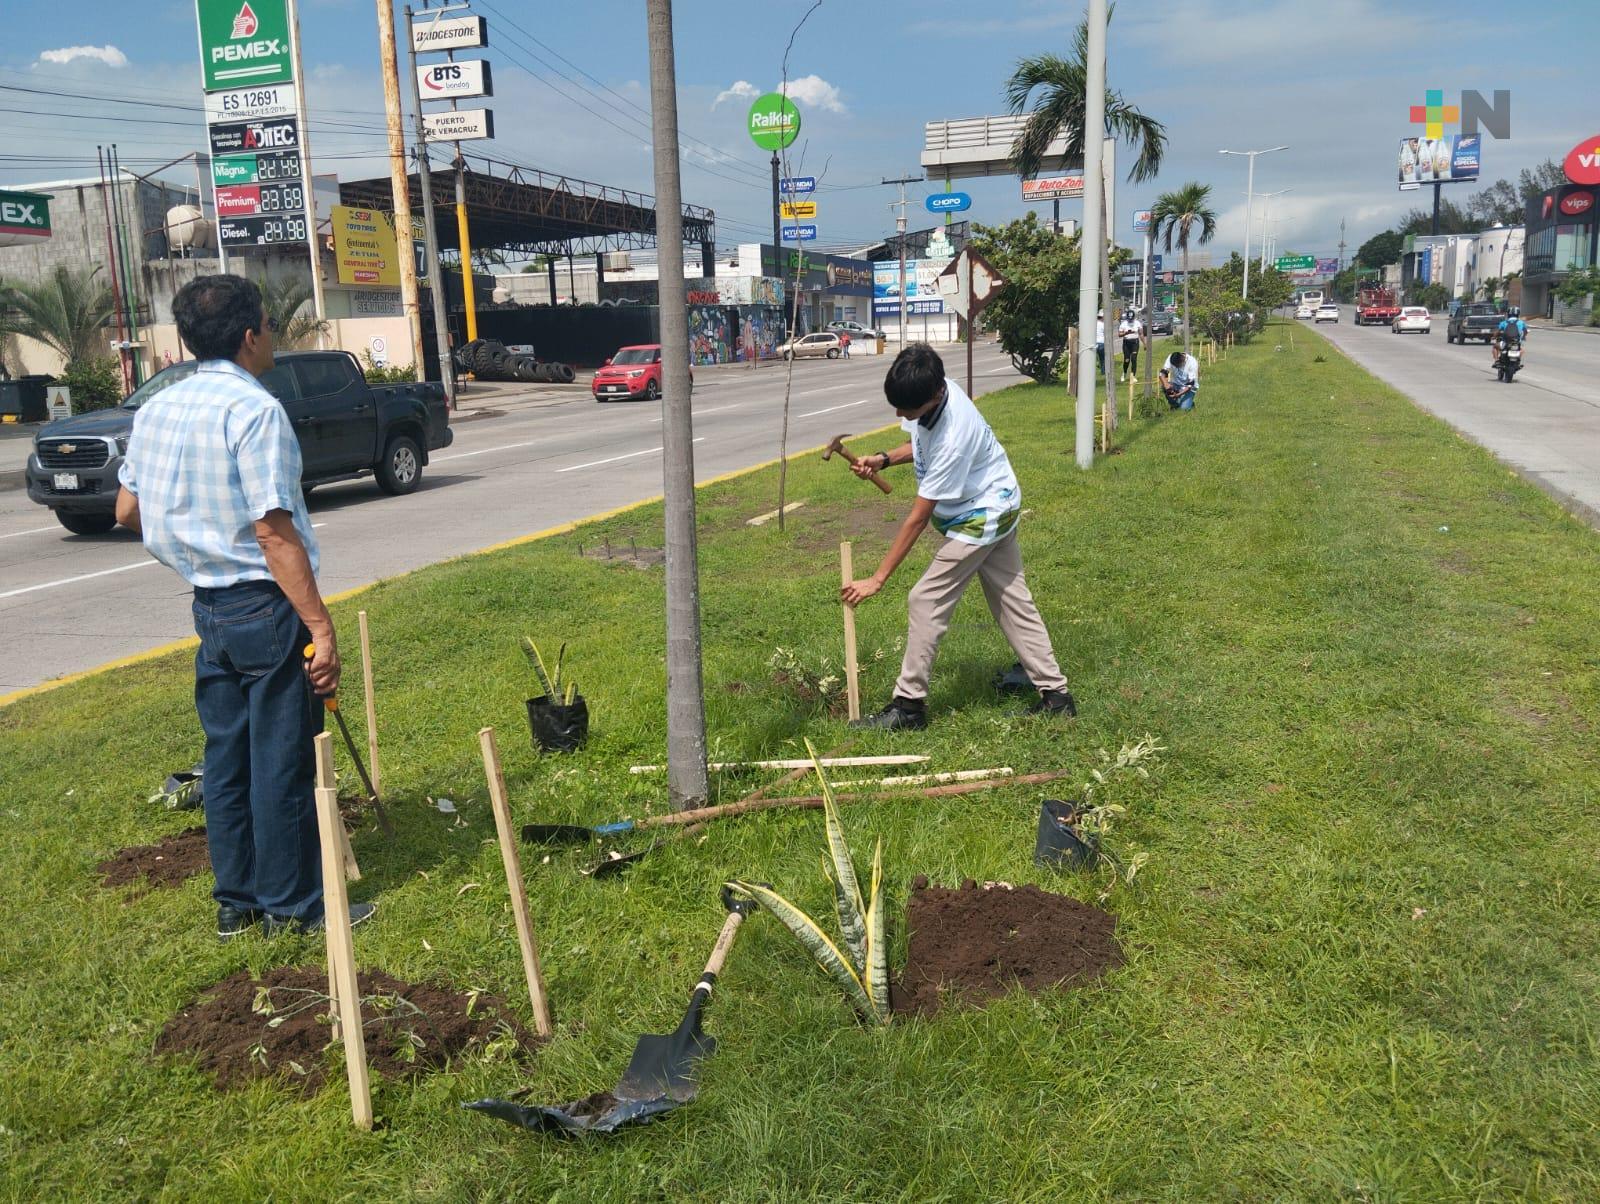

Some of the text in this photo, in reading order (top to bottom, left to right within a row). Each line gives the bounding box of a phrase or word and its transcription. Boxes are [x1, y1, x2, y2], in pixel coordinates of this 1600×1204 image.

[212, 39, 280, 63] PEMEX
[433, 65, 461, 81] BTS
[223, 89, 278, 110] ES 12691
[436, 117, 465, 125] PUERTO
[439, 126, 478, 135] VERACRUZ
[215, 167, 245, 178] Magna
[1039, 178, 1084, 189] AutoZon
[219, 197, 255, 208] Premium
[933, 198, 961, 206] CHOPO
[1566, 198, 1589, 208] vips
[221, 228, 247, 239] Diesel
